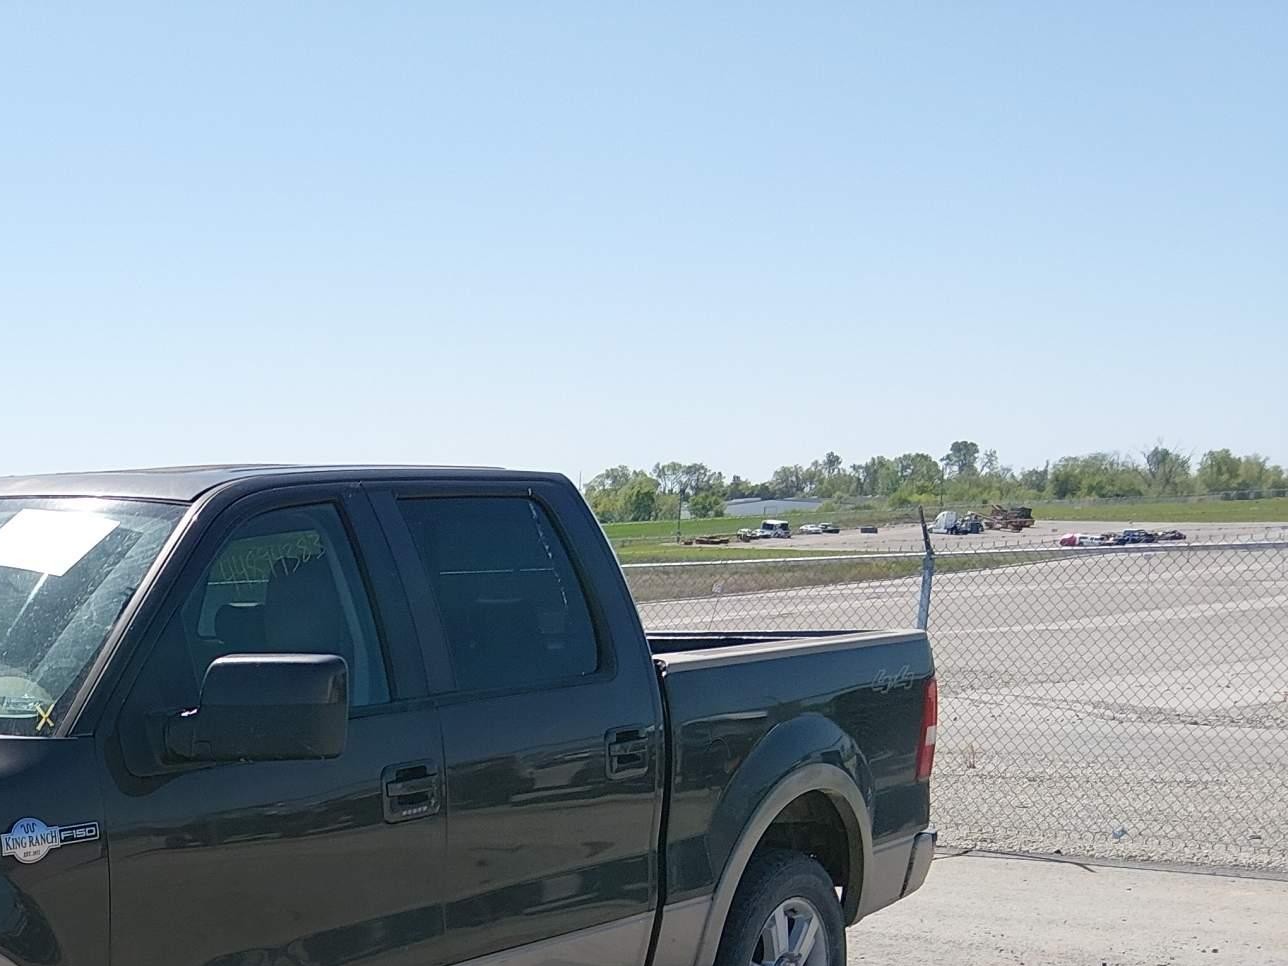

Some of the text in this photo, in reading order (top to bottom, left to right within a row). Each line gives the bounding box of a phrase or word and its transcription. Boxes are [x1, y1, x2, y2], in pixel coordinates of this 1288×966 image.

[4, 828, 96, 851] KING RANCH F150
